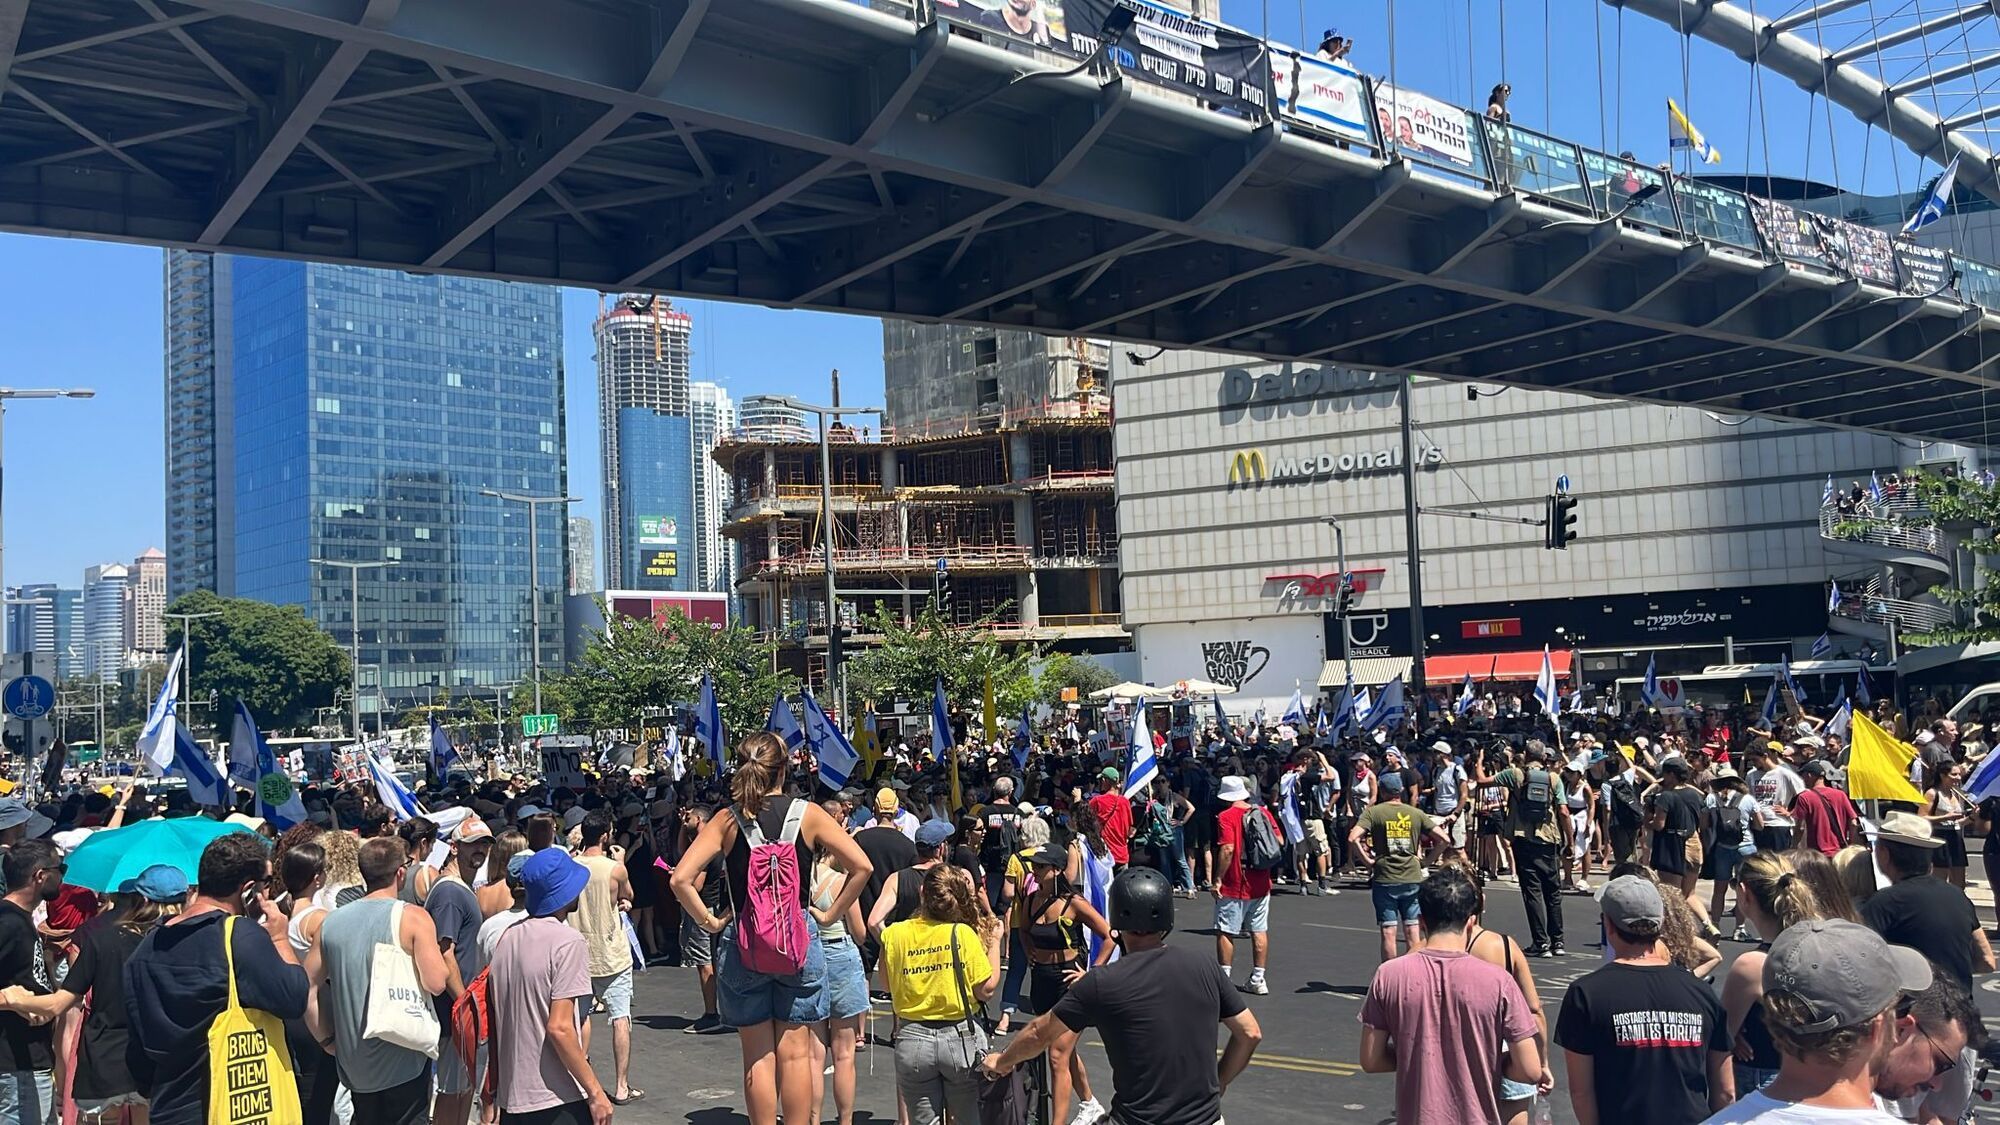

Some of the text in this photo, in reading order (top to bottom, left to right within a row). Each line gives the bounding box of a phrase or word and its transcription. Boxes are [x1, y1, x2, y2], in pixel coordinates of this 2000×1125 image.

[1416, 123, 1466, 150] הנהדרים
[1431, 115, 1465, 136] כולנו
[1205, 660, 1248, 683] GOOD
[1612, 1011, 1651, 1026] HOSTAGES
[1668, 1011, 1702, 1026] MISSING
[1614, 1023, 1702, 1043] FAMILIES FORUM
[229, 1032, 265, 1060] BRING
[229, 1061, 266, 1089] THEM
[232, 1089, 270, 1119] HOME
